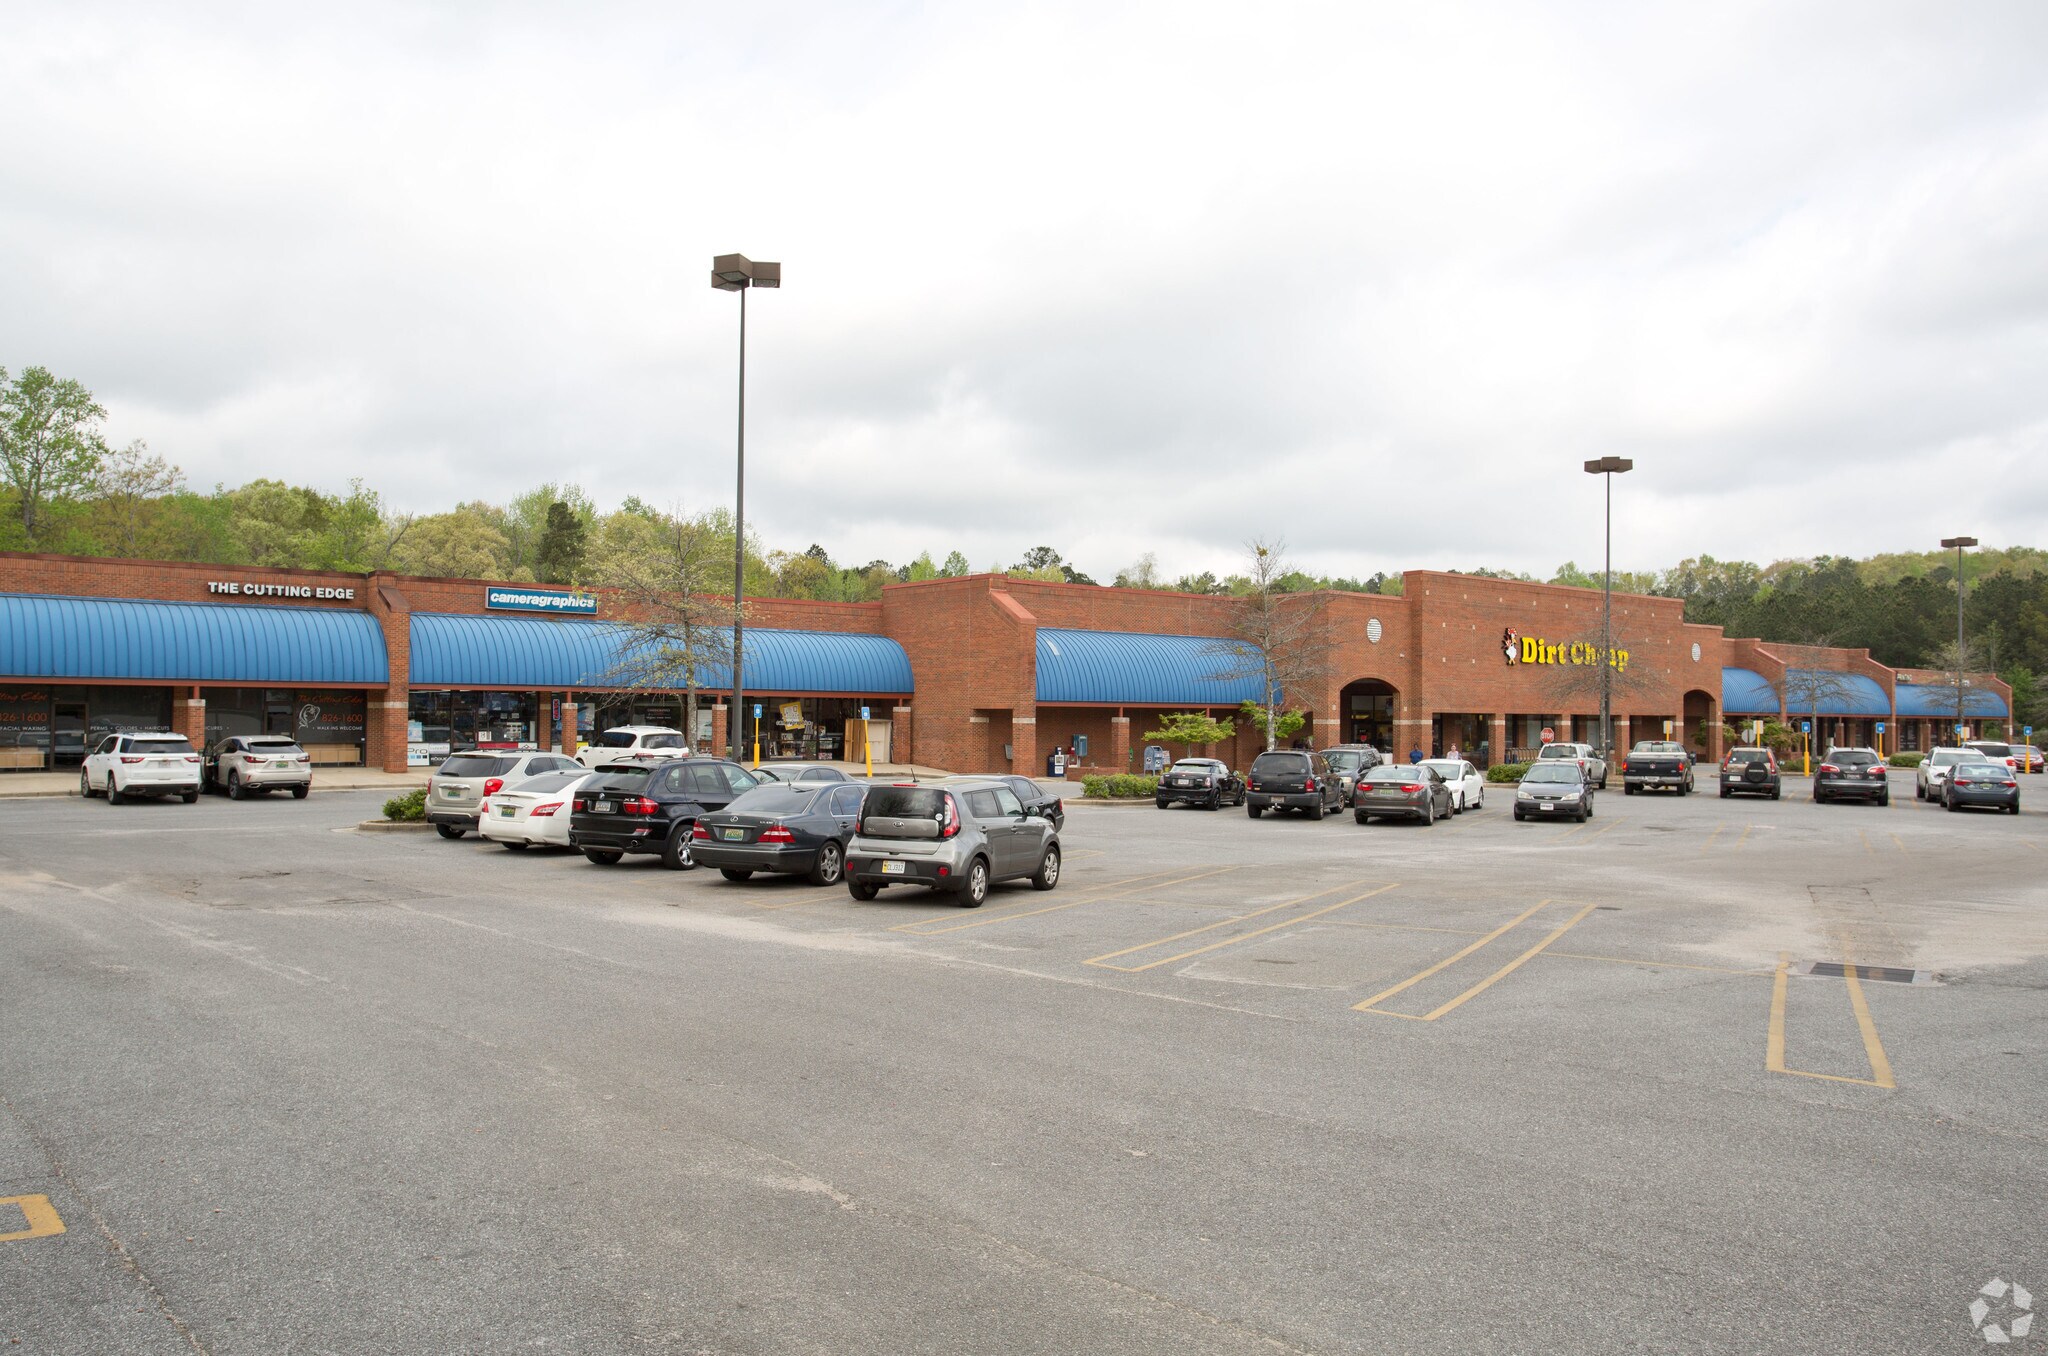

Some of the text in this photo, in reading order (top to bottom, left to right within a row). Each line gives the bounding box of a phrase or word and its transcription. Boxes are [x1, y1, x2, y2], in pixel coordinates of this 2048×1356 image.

[208, 582, 355, 600] THE CUTTING EDGE
[490, 592, 595, 609] cameragraphics
[1521, 637, 1567, 665] Dirt
[321, 713, 363, 722] 826-1600
